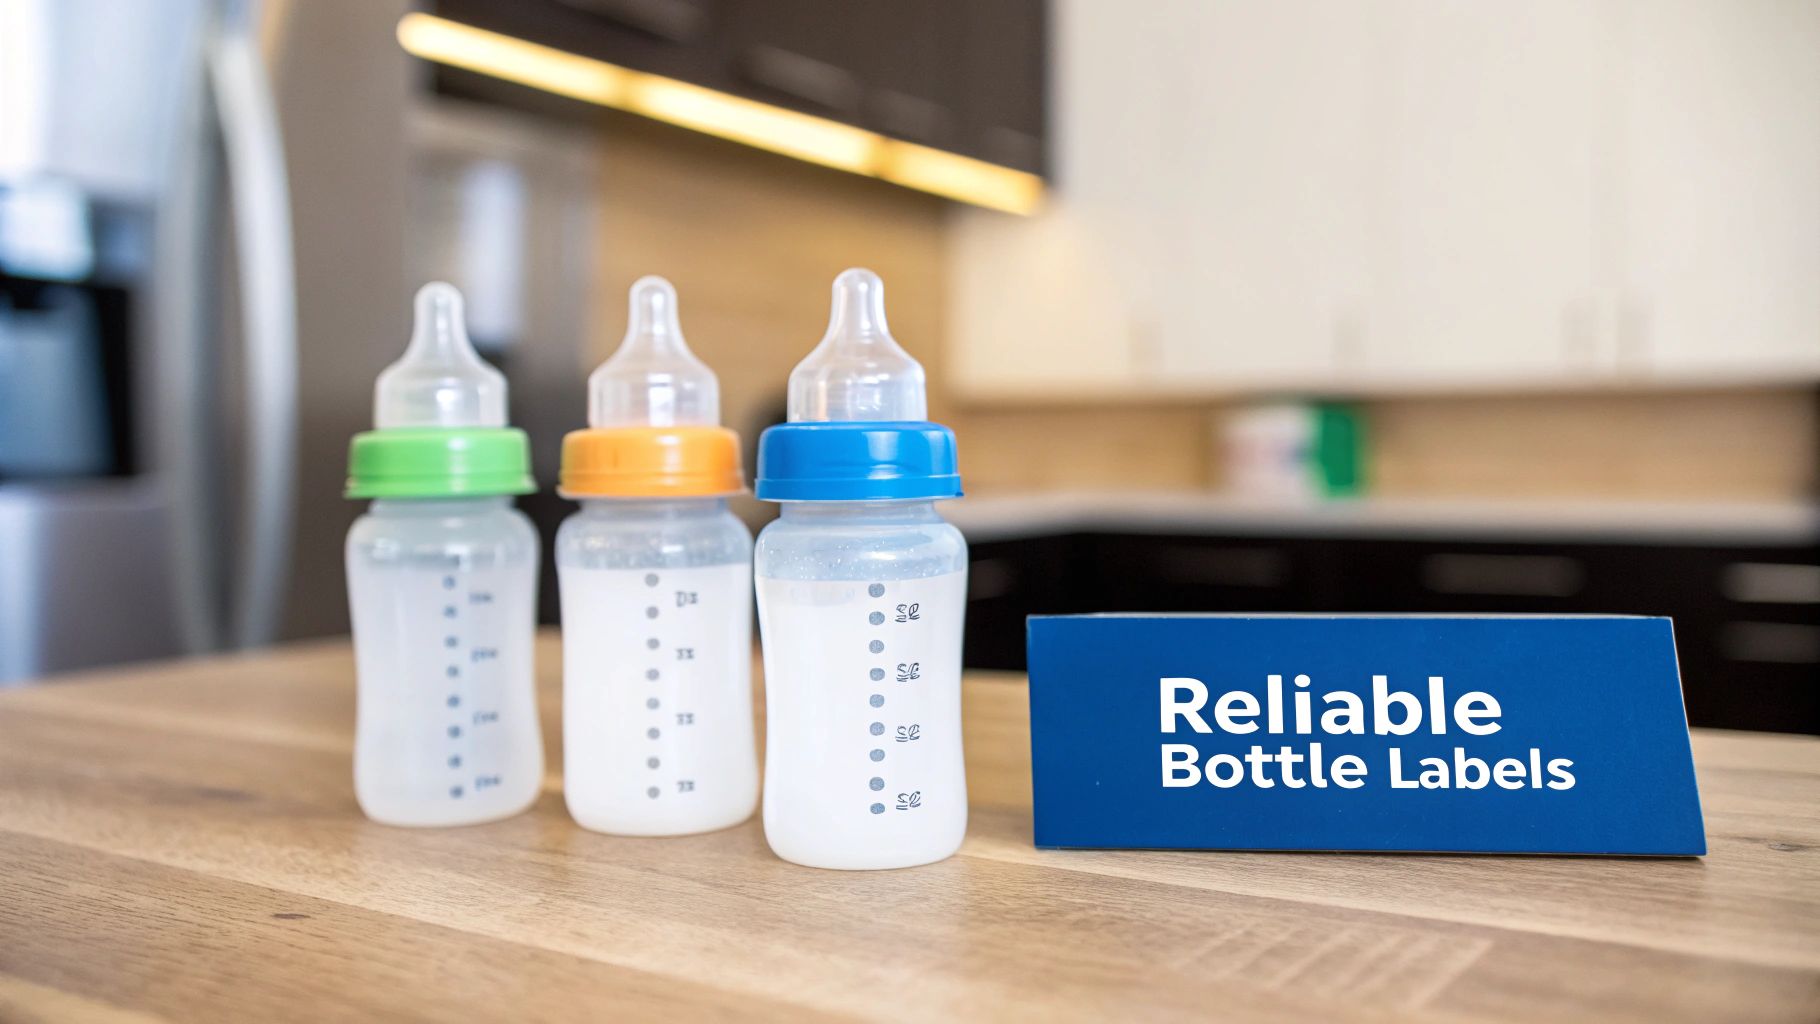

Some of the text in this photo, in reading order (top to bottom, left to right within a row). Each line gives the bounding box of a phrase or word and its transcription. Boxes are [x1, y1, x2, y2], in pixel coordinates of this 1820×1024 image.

[1160, 674, 1502, 736] Reliable
[1161, 742, 1576, 791] Bottle Labels
